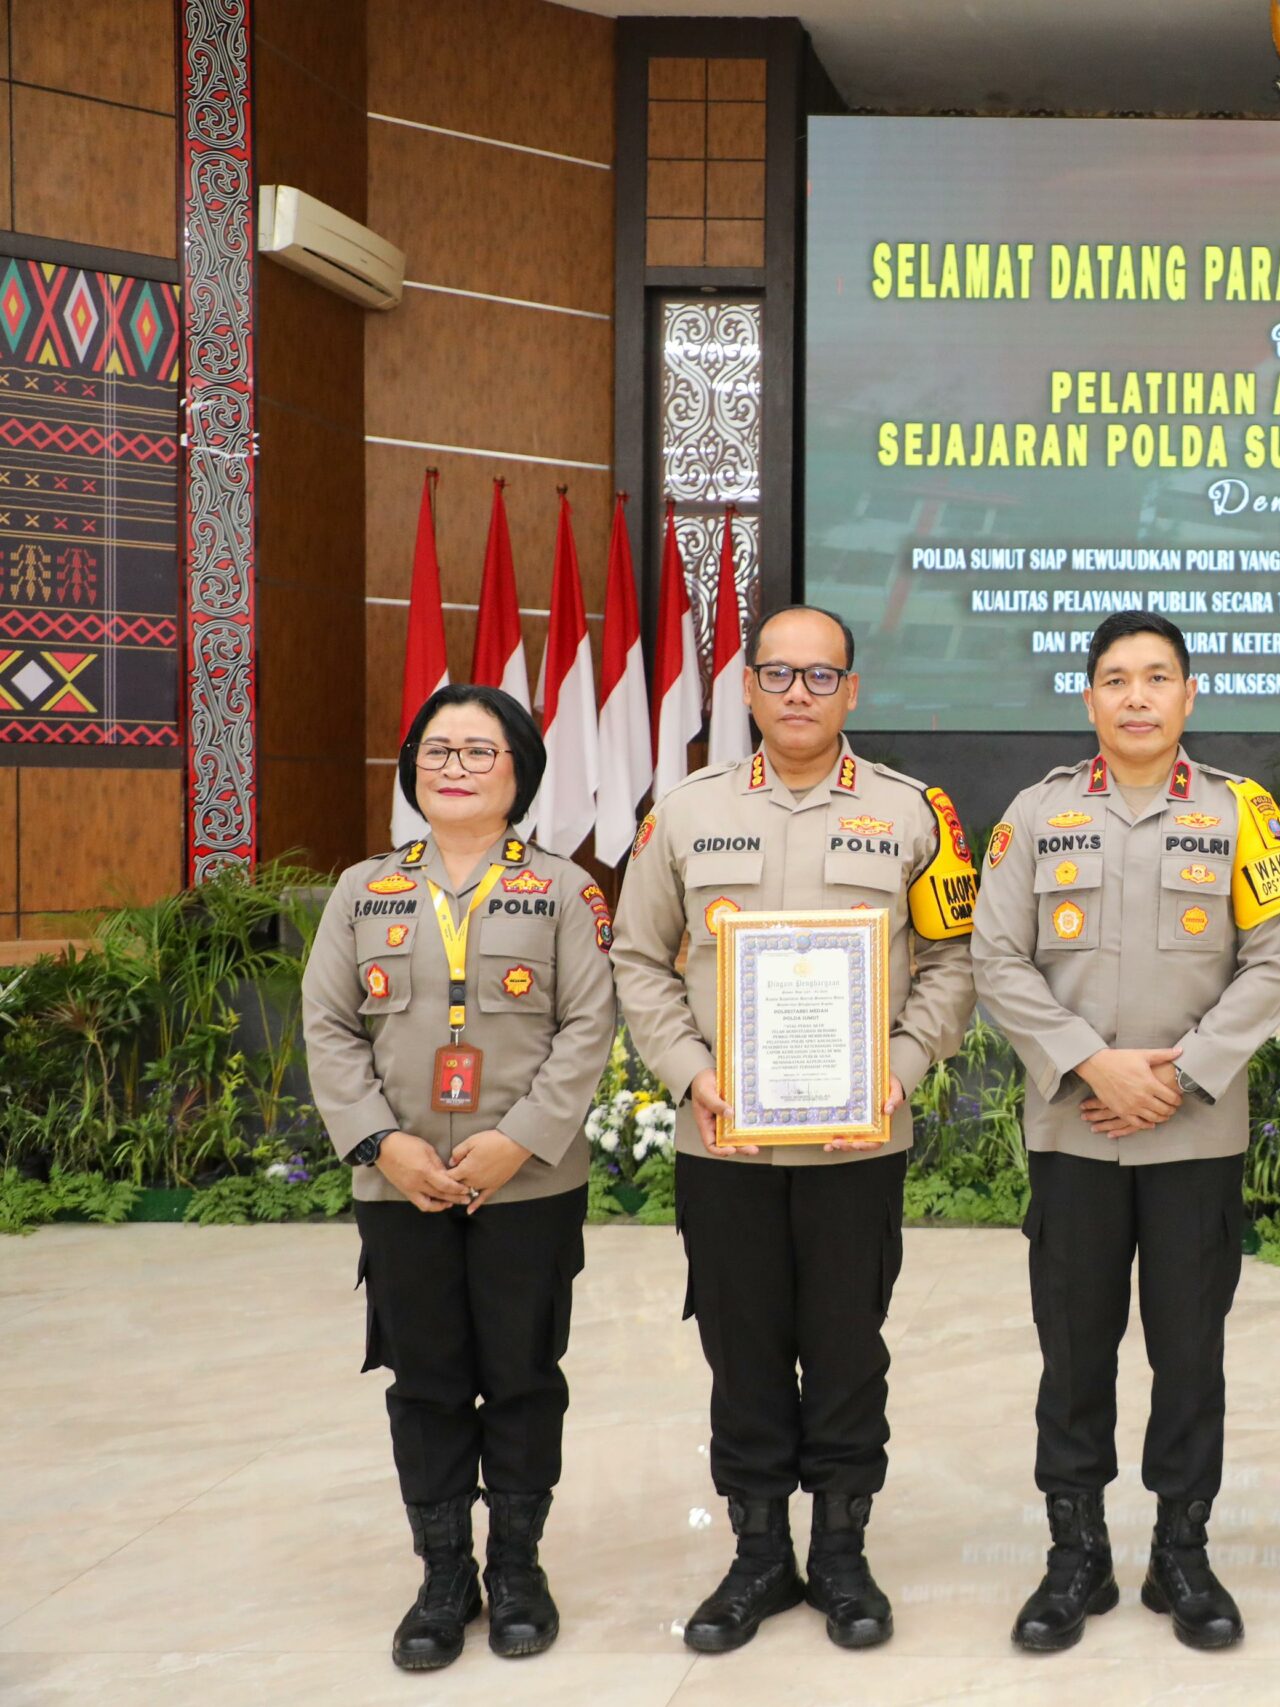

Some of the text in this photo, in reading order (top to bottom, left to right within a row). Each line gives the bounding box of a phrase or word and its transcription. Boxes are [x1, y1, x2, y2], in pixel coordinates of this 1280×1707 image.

[872, 242, 1034, 299] SELAMAT
[1050, 244, 1187, 300] DATANG
[1051, 371, 1256, 415] PELATIHAN
[878, 422, 1089, 467] SEJAJARAN
[1106, 424, 1229, 468] POLDA
[912, 549, 966, 570] POLDA
[970, 549, 1026, 570] SUMUT
[1030, 549, 1067, 570] SIAP
[1072, 550, 1181, 571] MEWUJUDKAN
[1186, 550, 1235, 571] POLRI
[1240, 550, 1280, 571] YANG
[972, 590, 1048, 611] KUALITAS
[1053, 590, 1143, 611] PELAYANAN
[1147, 591, 1207, 612] PUBLIK
[1212, 592, 1274, 613] SECARA
[1033, 631, 1066, 652] DAN
[1054, 672, 1091, 694] SER
[693, 837, 760, 853] GIDION
[831, 837, 899, 857] POLRI
[1038, 834, 1101, 856] RONY.S
[1166, 836, 1229, 855] POLRI
[488, 899, 555, 917] POLRI
